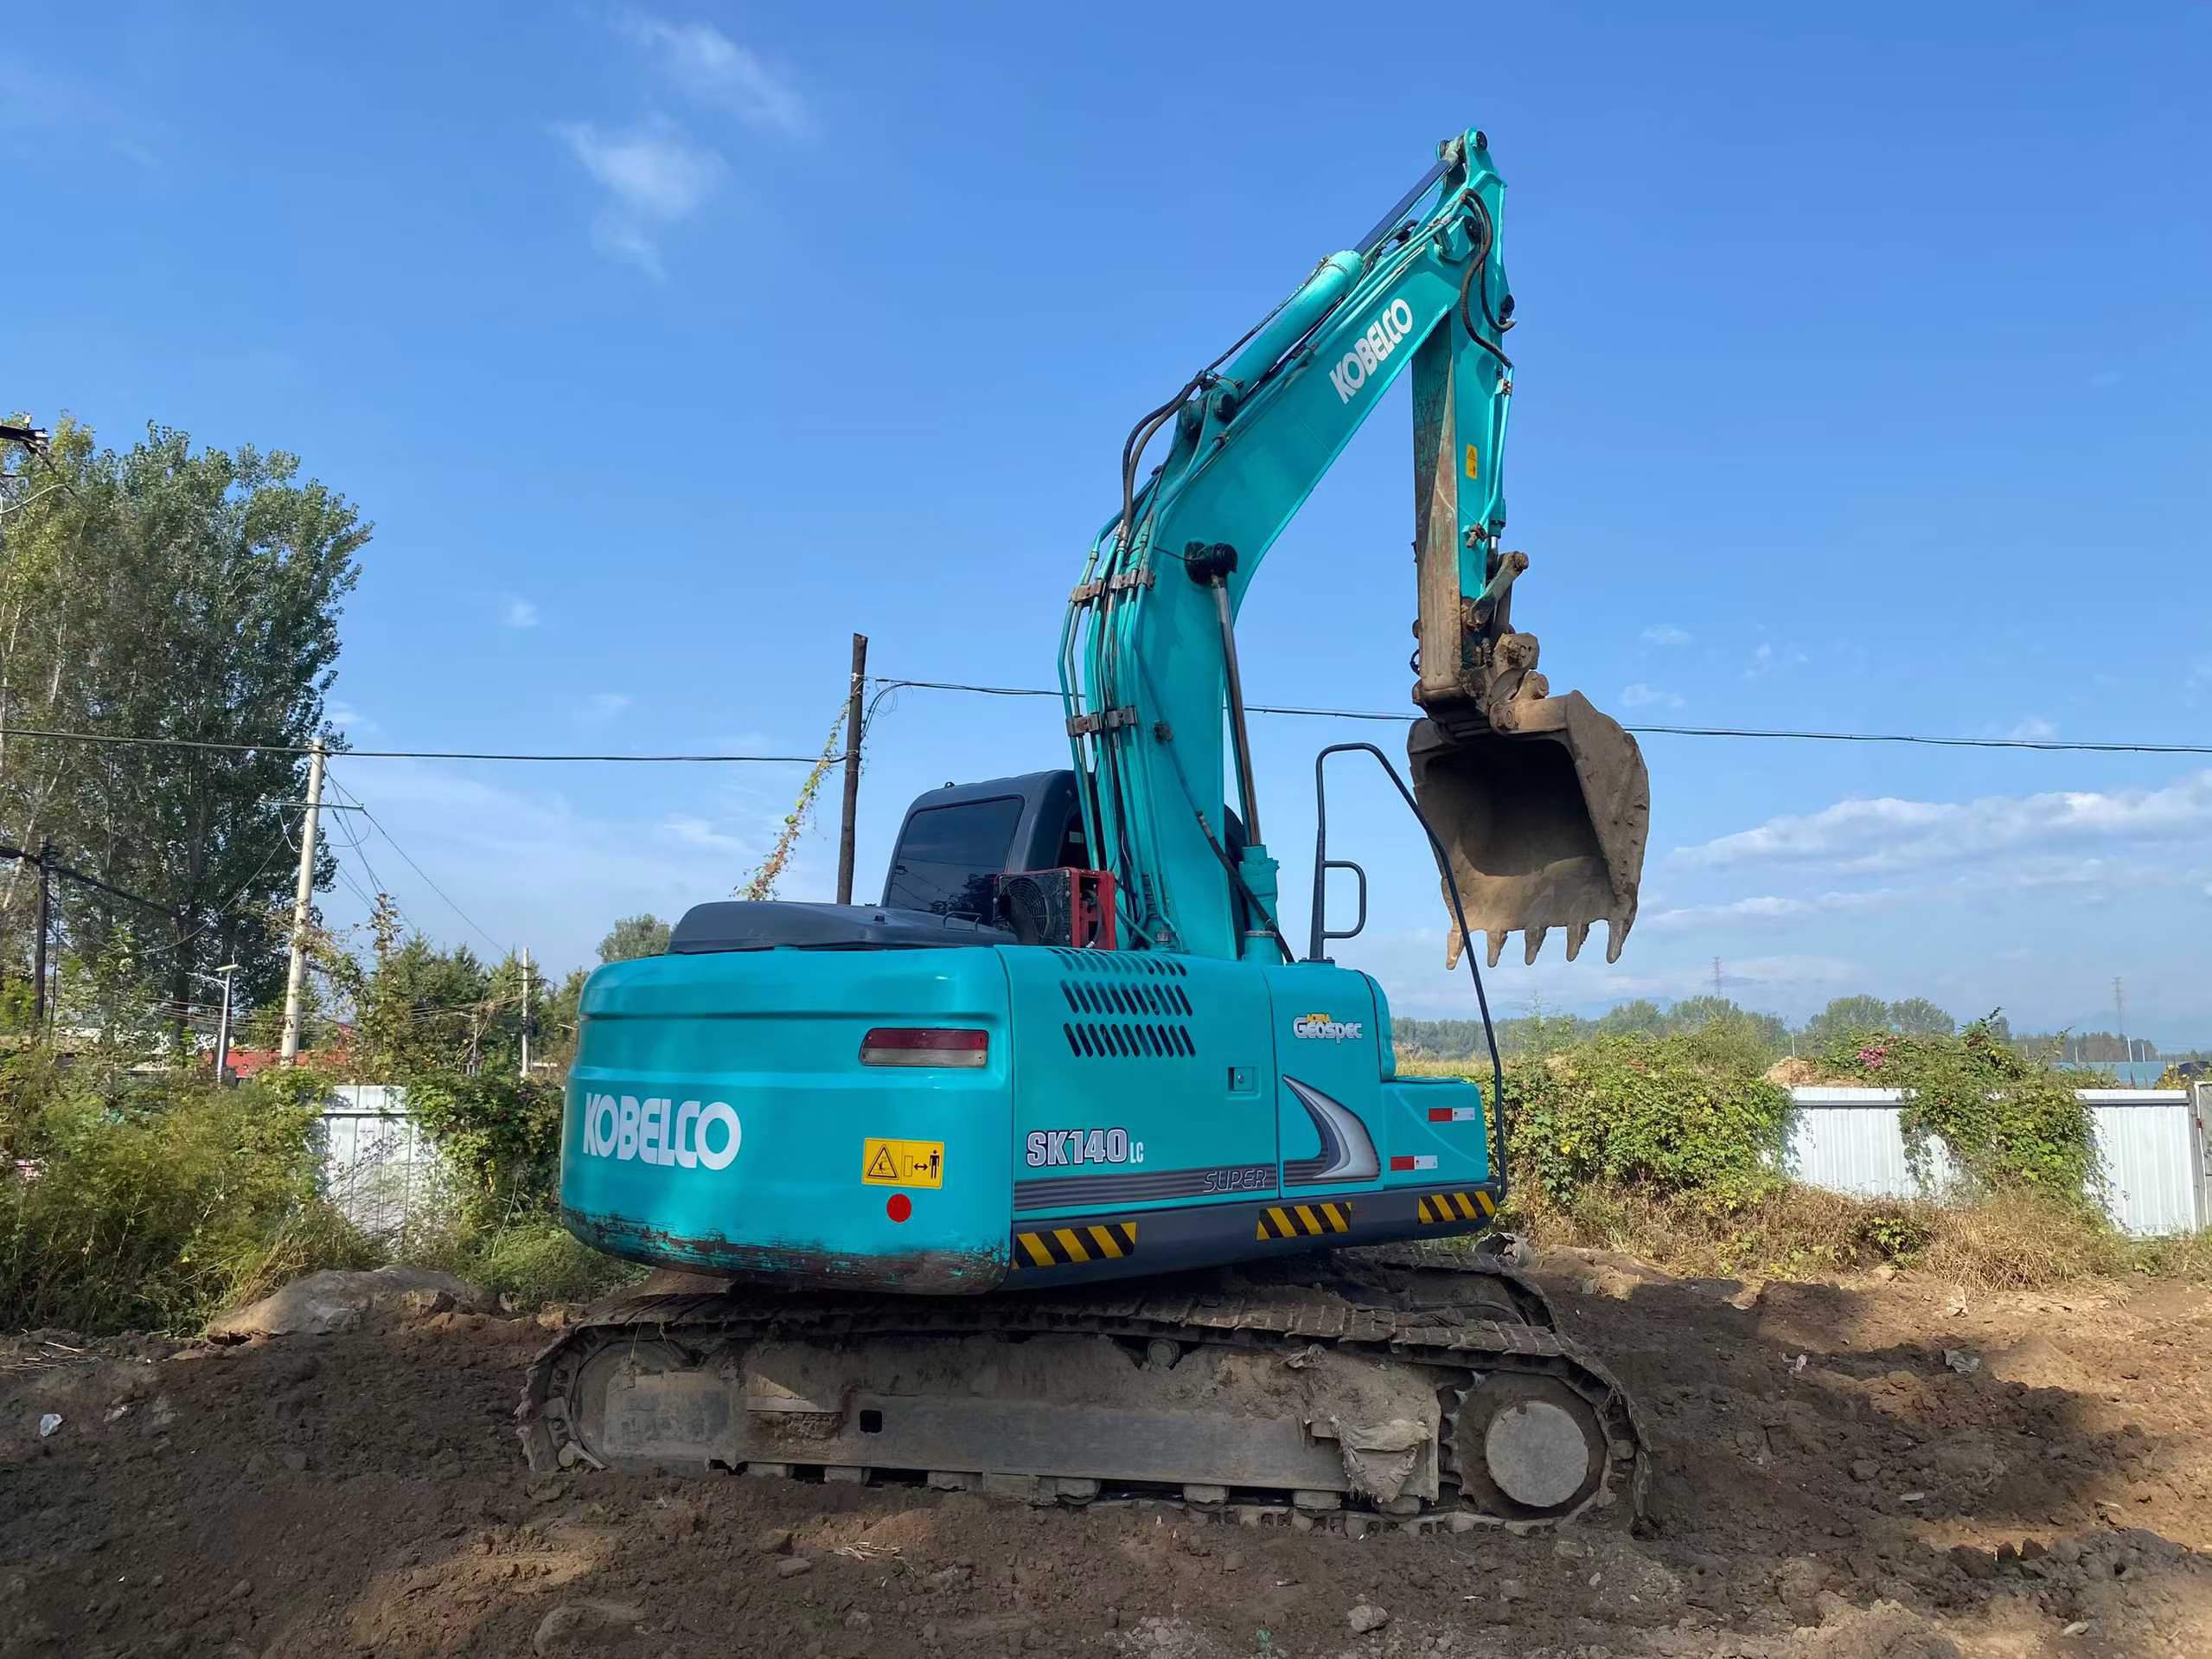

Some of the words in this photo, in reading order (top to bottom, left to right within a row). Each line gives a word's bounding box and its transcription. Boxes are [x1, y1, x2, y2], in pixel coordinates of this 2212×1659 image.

[1328, 298, 1413, 405] KOBELCO
[583, 1092, 742, 1170] KOBELCO
[1203, 1169, 1267, 1193] SUPER
